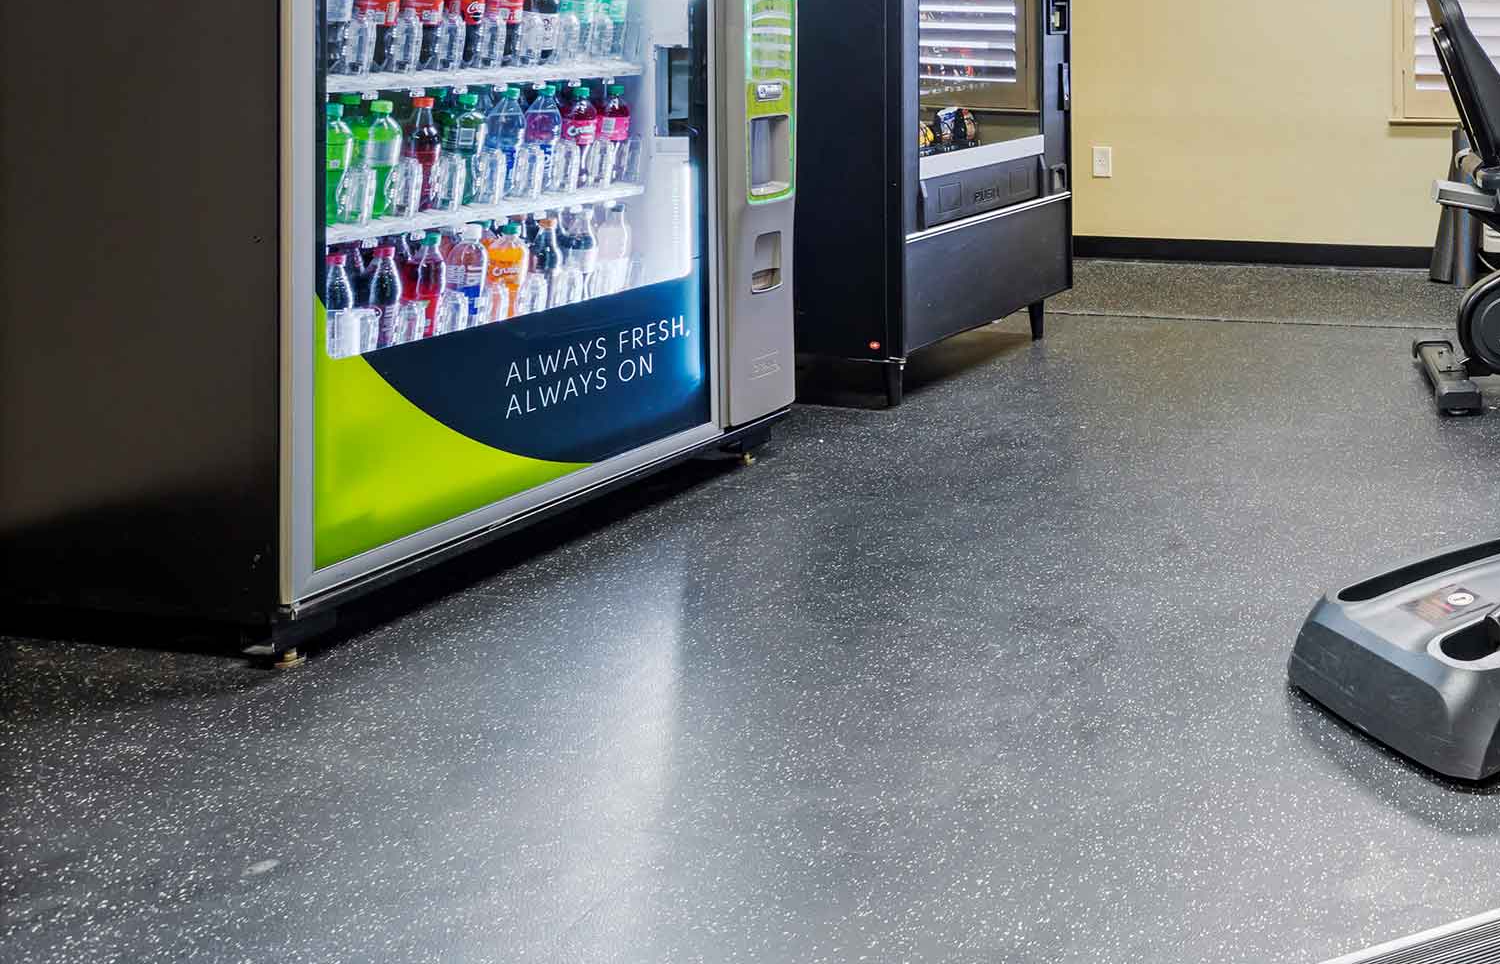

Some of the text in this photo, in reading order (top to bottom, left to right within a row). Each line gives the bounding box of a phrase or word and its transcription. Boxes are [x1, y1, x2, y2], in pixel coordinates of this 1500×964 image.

[505, 314, 691, 387] ALWAYS FRESH,
[505, 352, 653, 420] ALWAYS ON
